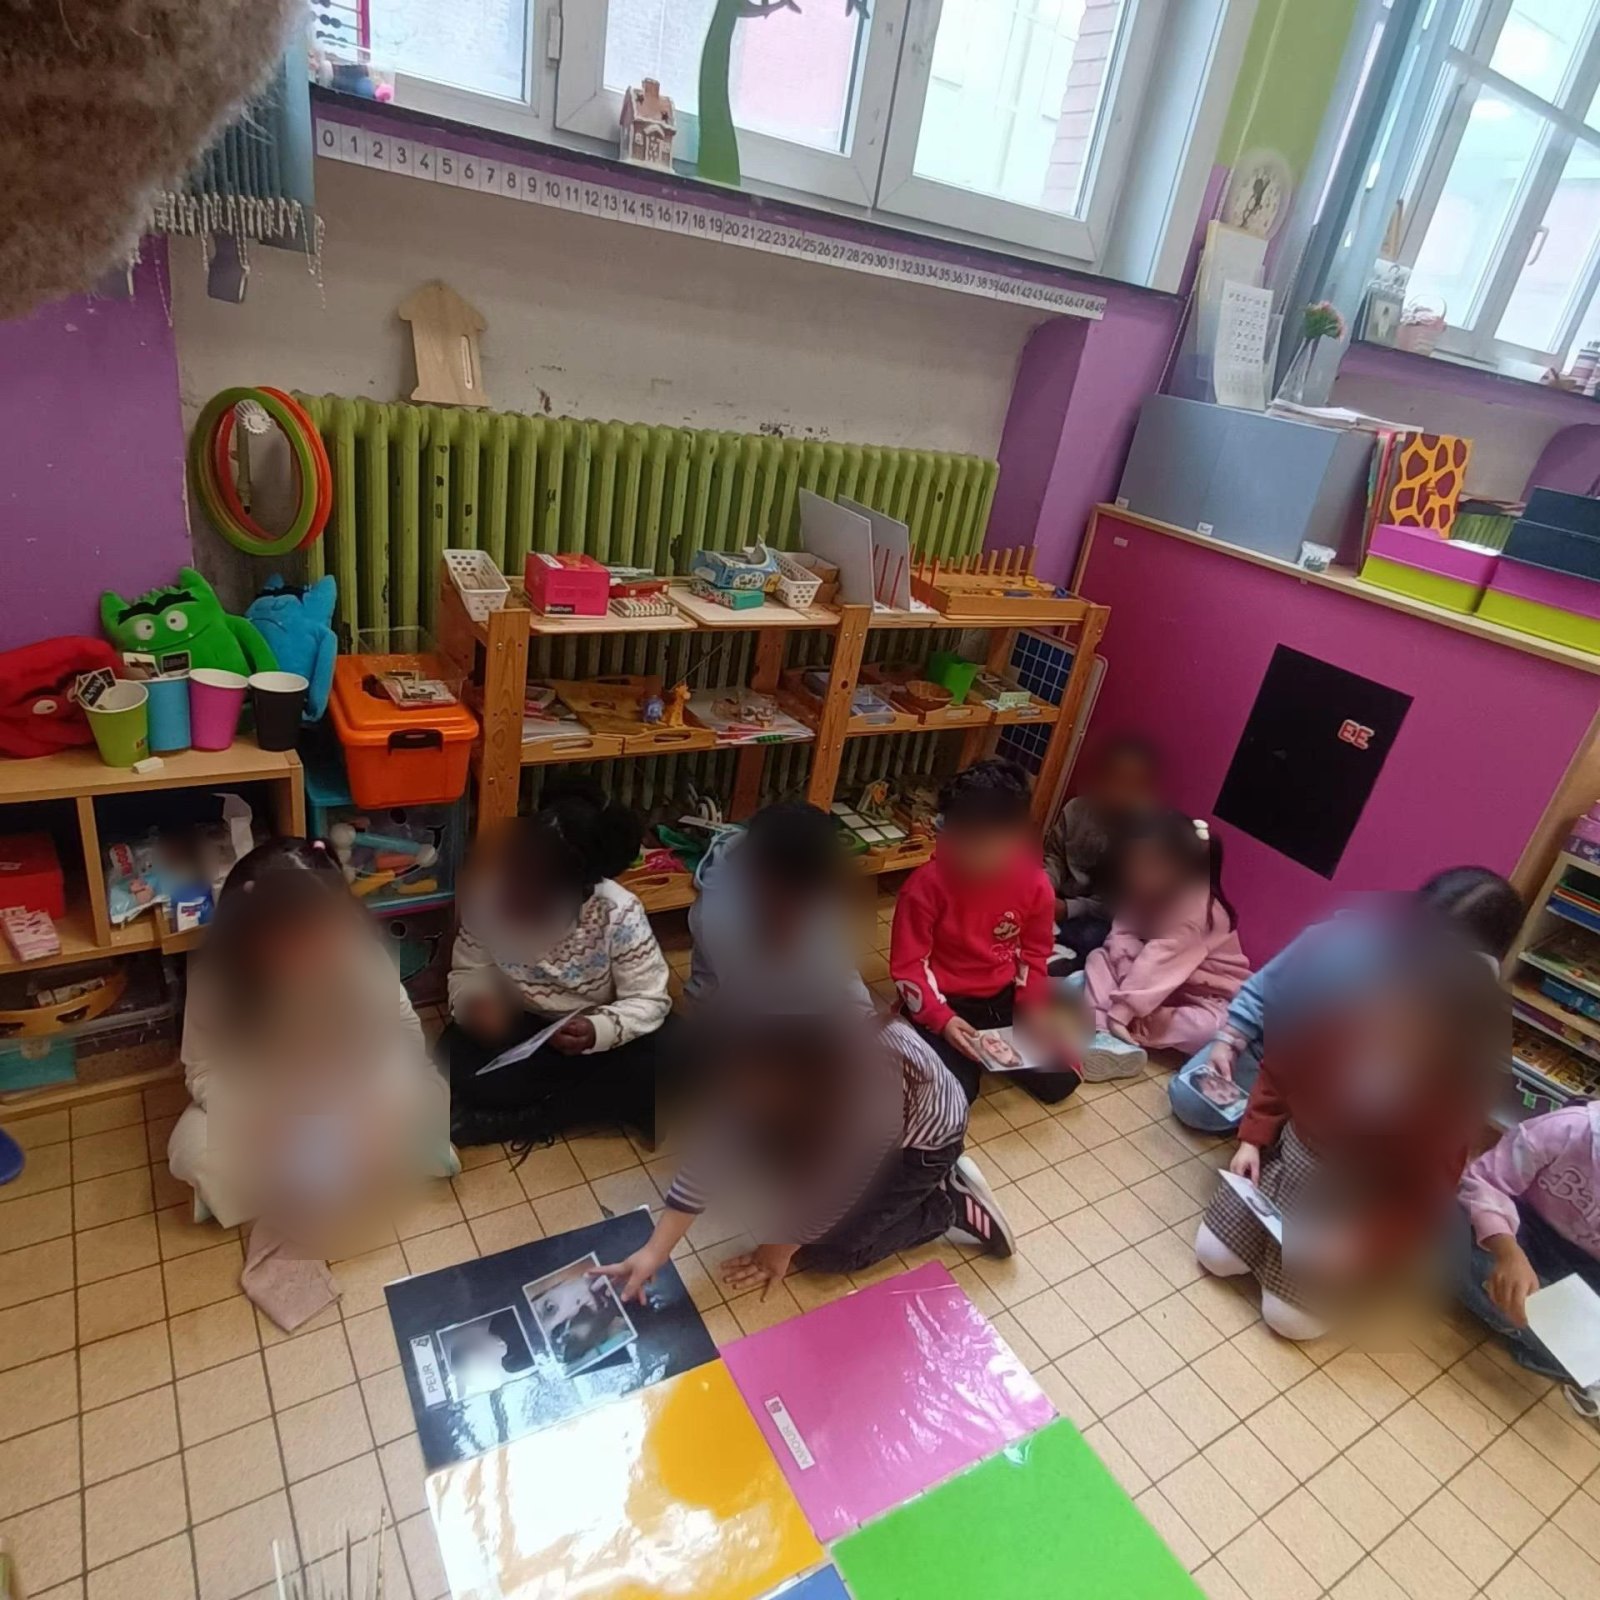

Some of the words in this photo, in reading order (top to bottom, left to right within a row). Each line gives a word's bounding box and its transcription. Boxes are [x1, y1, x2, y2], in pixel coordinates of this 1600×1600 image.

[323, 130, 334, 147] 0
[351, 136, 358, 153] 1
[373, 142, 383, 159] 2
[397, 147, 406, 164] 3
[420, 153, 428, 169] 4
[443, 159, 452, 174] 5
[465, 164, 474, 179] 6
[487, 168, 495, 183] 7
[507, 173, 516, 188] 8
[528, 177, 536, 192] 9
[546, 181, 560, 198] 10
[566, 186, 578, 201] 11
[585, 190, 598, 207] 12
[604, 195, 617, 211] 13
[623, 199, 635, 214] 14
[640, 202, 653, 218] 15
[658, 206, 671, 222] 16
[676, 211, 688, 226] 17
[693, 214, 705, 229] 18
[709, 217, 722, 232] 19
[725, 221, 739, 236] 20
[742, 225, 755, 239] 21
[757, 229, 770, 243] 22
[773, 232, 786, 246] 23
[788, 236, 801, 249] 24
[803, 239, 816, 253] 25
[818, 242, 830, 256] 26
[832, 245, 845, 259] 27
[847, 248, 859, 262] 28
[861, 251, 873, 265] 29
[875, 255, 887, 268] 30
[888, 257, 899, 270] 31
[901, 260, 912, 273] 32
[913, 263, 925, 276] 33
[926, 265, 937, 278] 34
[939, 268, 950, 281] 35
[952, 271, 962, 284] 36
[964, 273, 975, 286] 37
[977, 277, 987, 289] 38
[422, 1362, 439, 1394] PEUR
[782, 1424, 810, 1465] AMOUR
